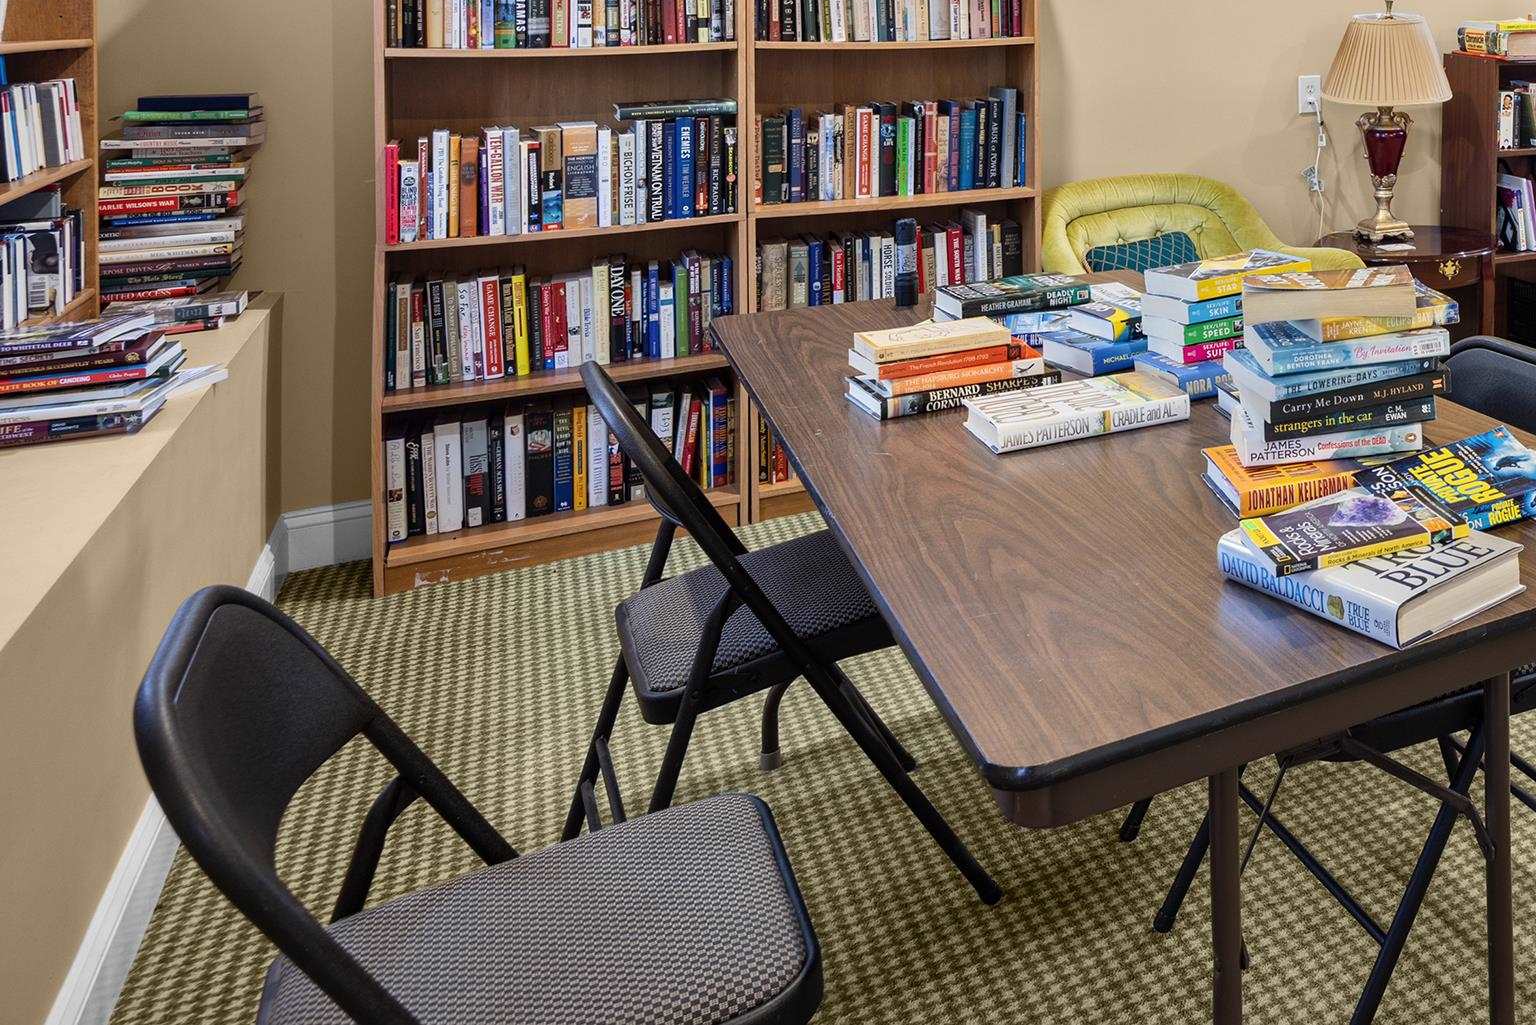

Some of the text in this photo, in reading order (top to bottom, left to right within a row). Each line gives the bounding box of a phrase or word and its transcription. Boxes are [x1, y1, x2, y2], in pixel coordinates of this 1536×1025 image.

[990, 122, 998, 177] ABUSE POWER
[680, 126, 691, 198] ENEMIES TIM WEINER
[624, 152, 634, 208] BICHON FRISE
[652, 146, 663, 219] VIETNAM ON TRIAL
[491, 185, 503, 204] WAR
[883, 245, 893, 269] HORSE
[137, 290, 172, 299] ACCESS
[611, 267, 624, 316] DAY ONE
[1047, 288, 1075, 299] DEADLY
[1217, 284, 1238, 292] STAR
[485, 283, 496, 337] GAME CHANGE
[981, 298, 1031, 312] HEATHER GRAHAM
[1049, 297, 1072, 306] NIGHT
[1209, 306, 1228, 316] SKIN
[1203, 328, 1230, 338] SPEED
[413, 340, 422, 369] Francisco
[1103, 352, 1130, 364] MICHAEL
[1206, 348, 1227, 358] SUIT
[1294, 354, 1333, 363] DOROTHEA
[1354, 345, 1368, 360] By
[1287, 359, 1340, 372] BENTON FRANK
[59, 376, 91, 384] CANOEING
[905, 366, 1004, 386] THE MONARCHY
[1308, 371, 1378, 392] LOWERING DAYS
[929, 385, 980, 402] BERNARD
[1186, 380, 1211, 396] NORA
[1283, 383, 1424, 415] Carry Me Down HYLAND
[1274, 411, 1372, 435] strangers in the car
[1386, 412, 1407, 421] EWAN
[1000, 406, 1161, 449] JAMES PATTERSON CRADLE and
[1264, 440, 1302, 452] JAMES
[1318, 436, 1387, 451] Confessions of the DEAD
[1251, 447, 1315, 462] PATTERSON
[1419, 447, 1506, 505] ROGUE
[1248, 485, 1295, 510] JONATHAN
[1299, 476, 1348, 503] KELLERMAN
[1491, 498, 1514, 512] PRIVATE
[1489, 505, 1521, 526] ROGUE
[1351, 552, 1376, 562] Minerals
[1384, 545, 1402, 554] North
[1402, 540, 1424, 550] America
[1382, 540, 1496, 590] BLUE
[1222, 552, 1326, 614] DAVID BALDACCI
[1346, 599, 1370, 620] TRUE
[1348, 614, 1371, 634] BLUE
